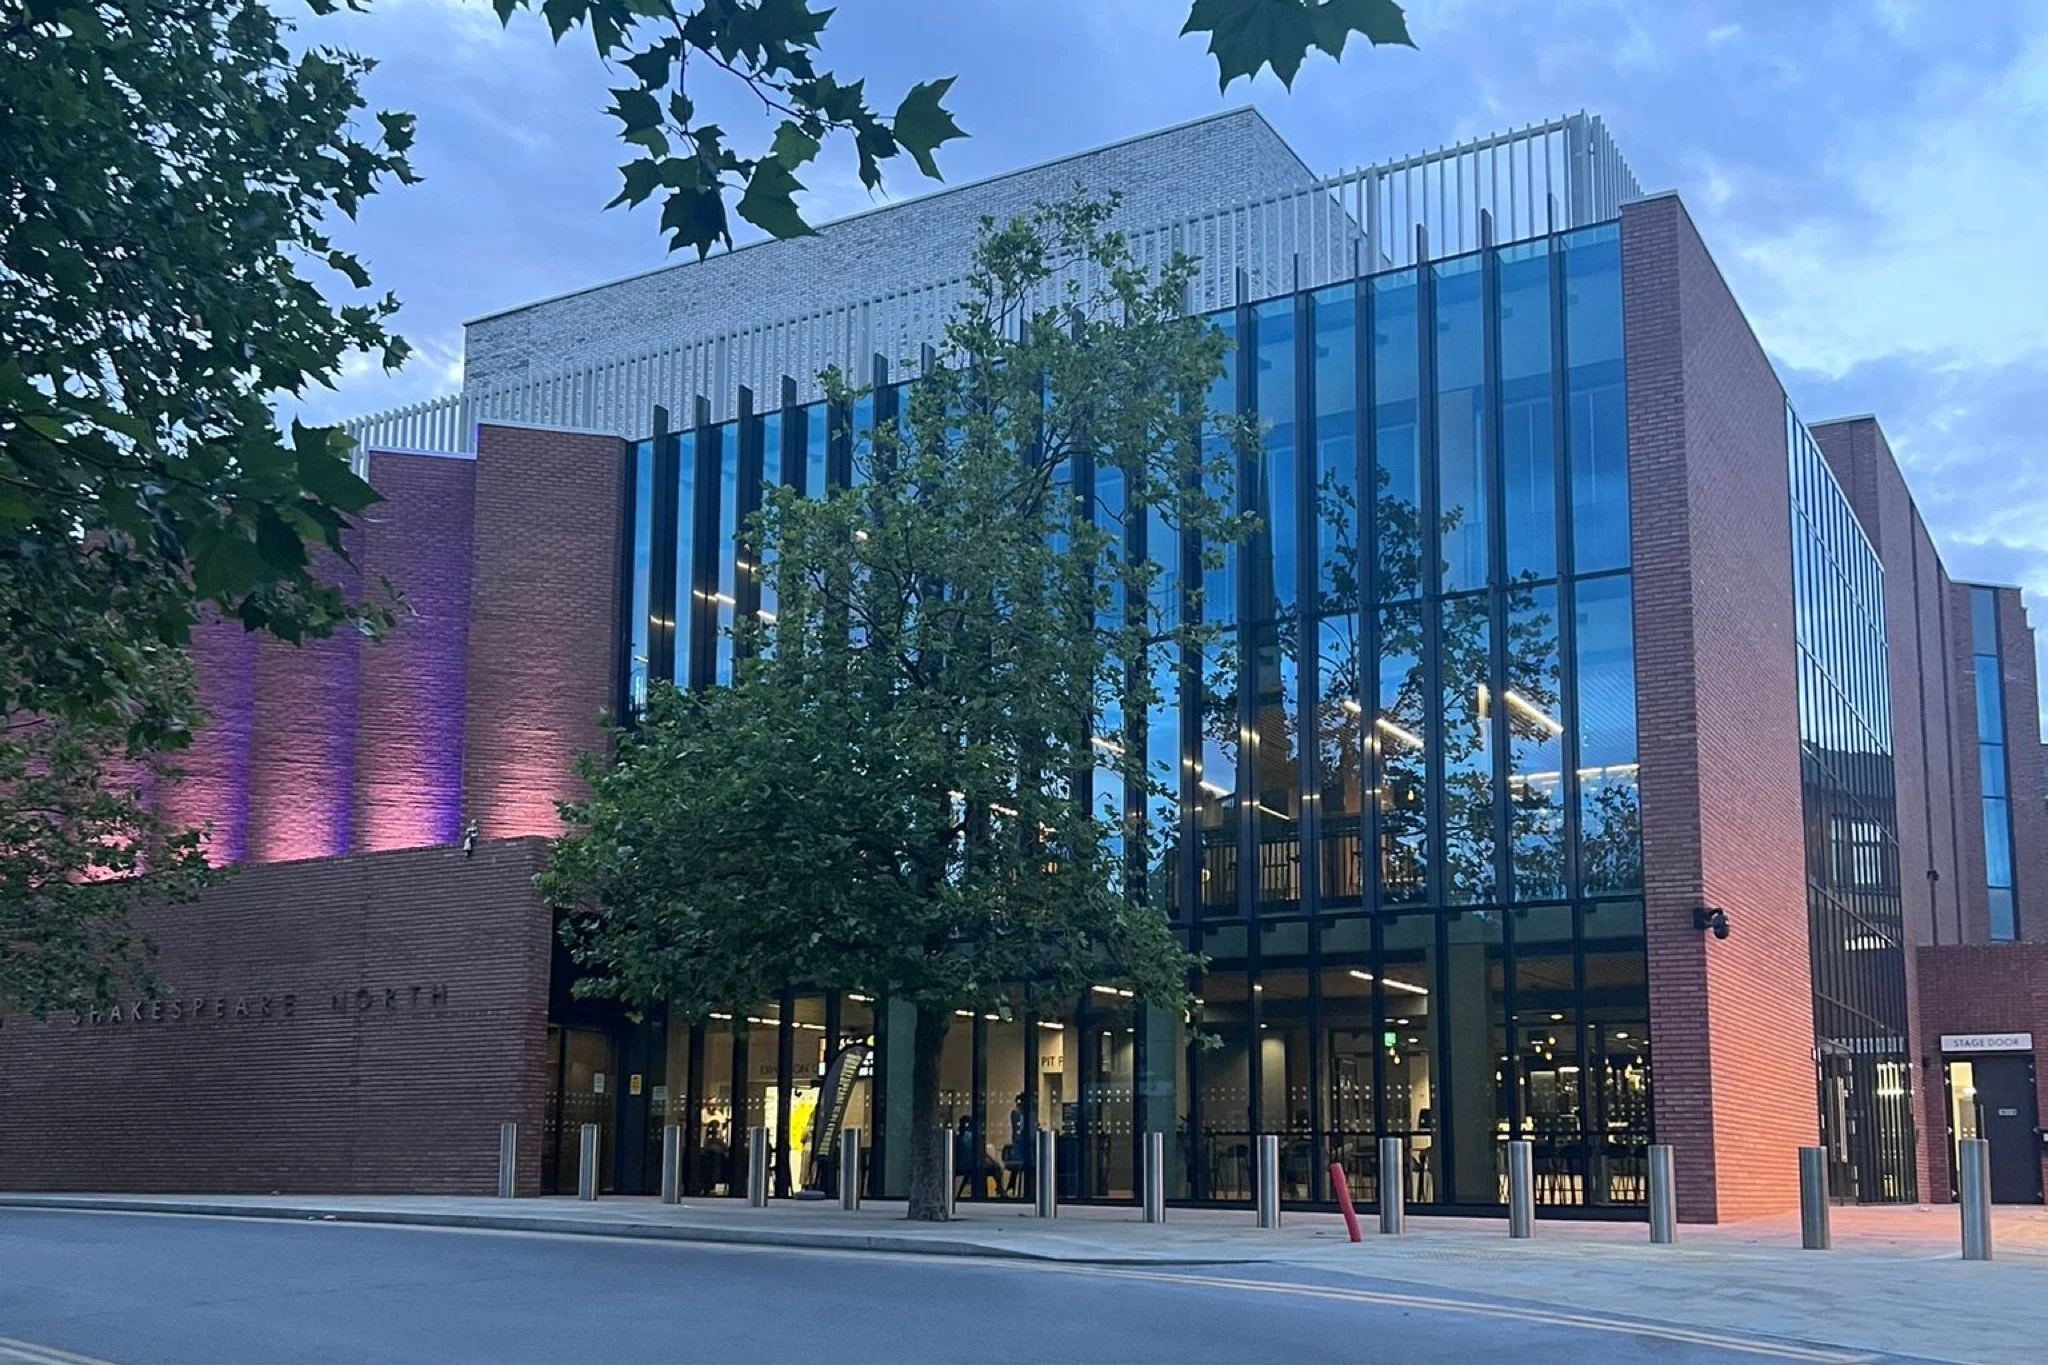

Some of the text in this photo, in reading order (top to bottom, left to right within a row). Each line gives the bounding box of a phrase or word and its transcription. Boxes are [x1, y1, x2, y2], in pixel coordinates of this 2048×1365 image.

[331, 984, 449, 1011] NORTH
[1953, 1037, 2019, 1048] STAGE DOOR
[1041, 1055, 1056, 1067] PIT
